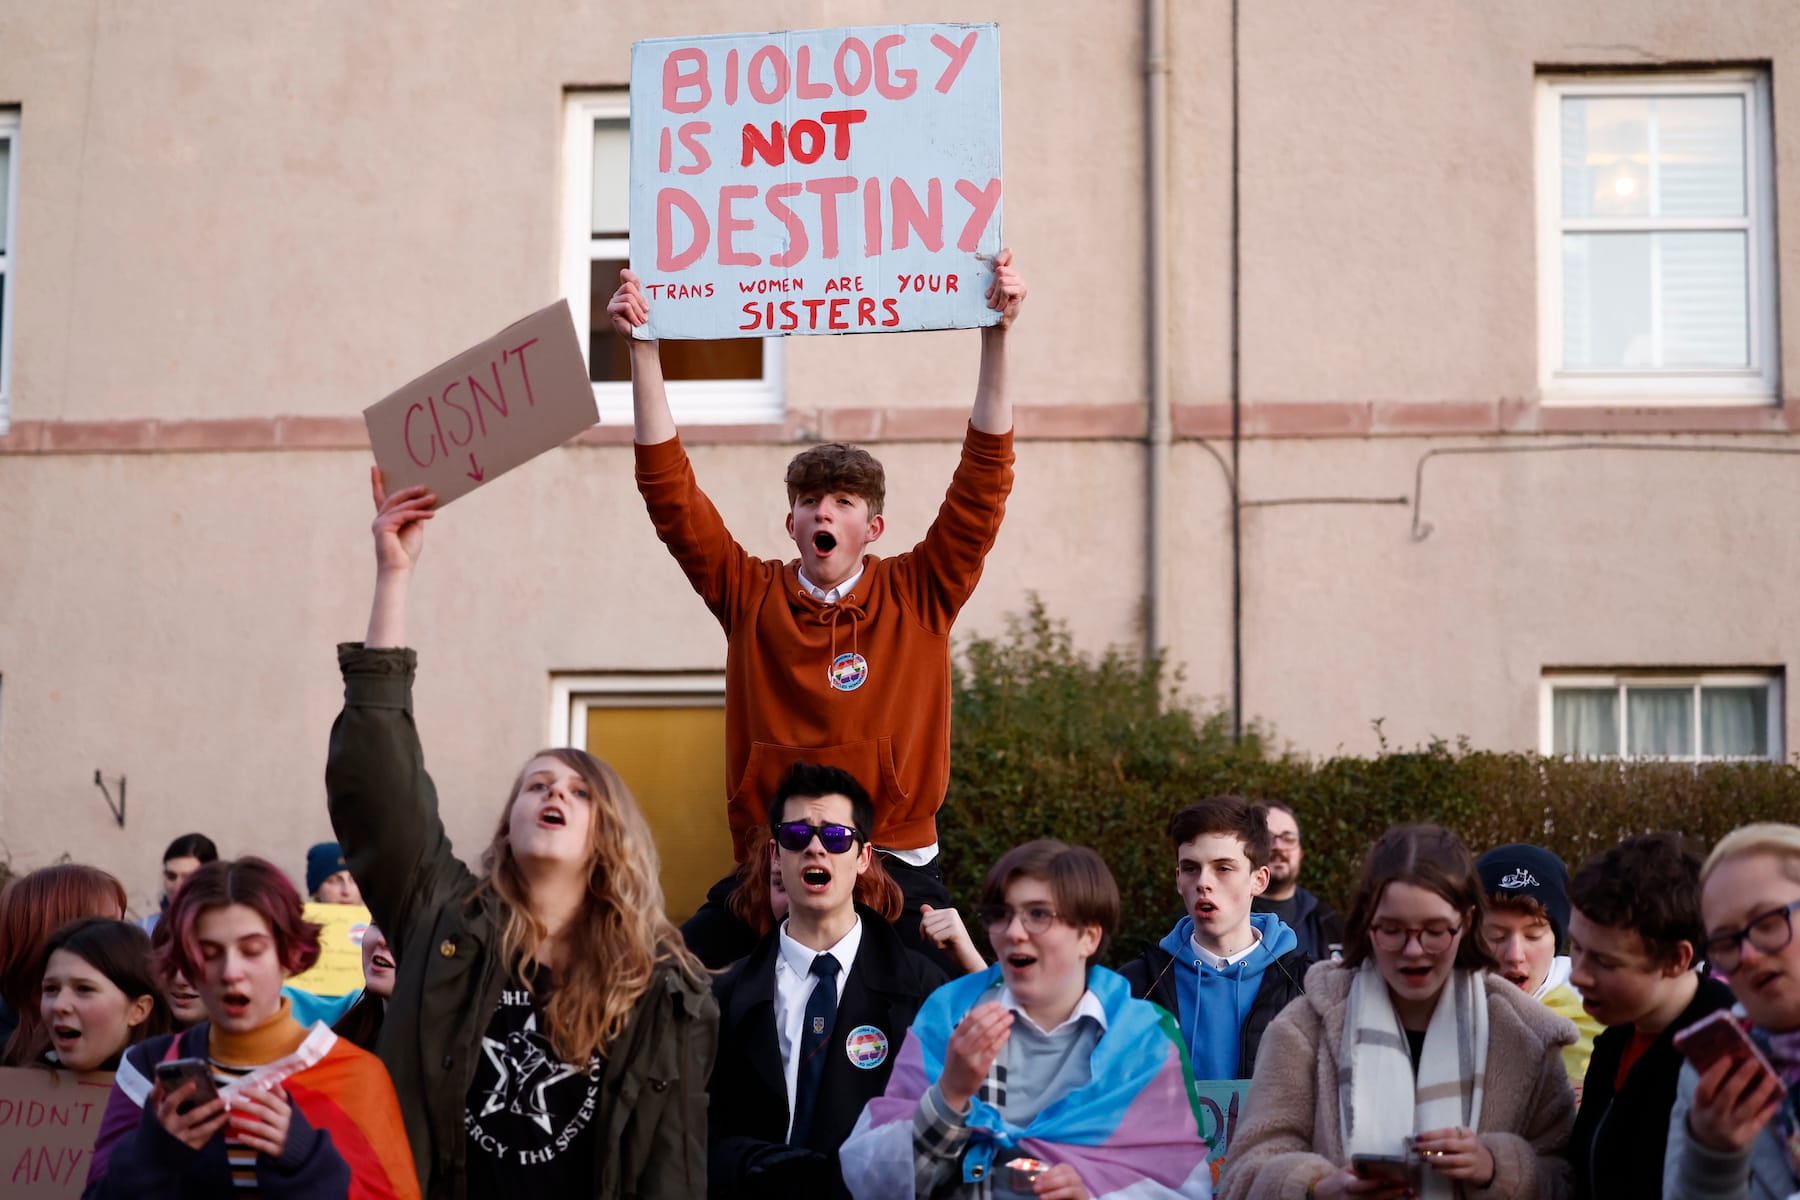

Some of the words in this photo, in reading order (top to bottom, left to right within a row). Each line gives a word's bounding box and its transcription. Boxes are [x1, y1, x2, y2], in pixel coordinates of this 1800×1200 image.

[662, 31, 978, 114] BIOLOGY
[659, 121, 712, 175] IS
[741, 109, 867, 167] NOT
[656, 176, 1002, 272] DESTINY
[646, 281, 714, 300] TRANS
[739, 277, 804, 295] WOMEN
[825, 275, 864, 294] ARE
[898, 273, 959, 294] YOUR
[739, 298, 901, 330] SISTERS
[404, 337, 539, 468] CISN'T
[0, 1100, 95, 1128] DIDN'T
[464, 1108, 509, 1159] ERCY
[518, 1144, 556, 1165] THE
[555, 1086, 599, 1152] SISTERS
[11, 1145, 95, 1187] ANY
